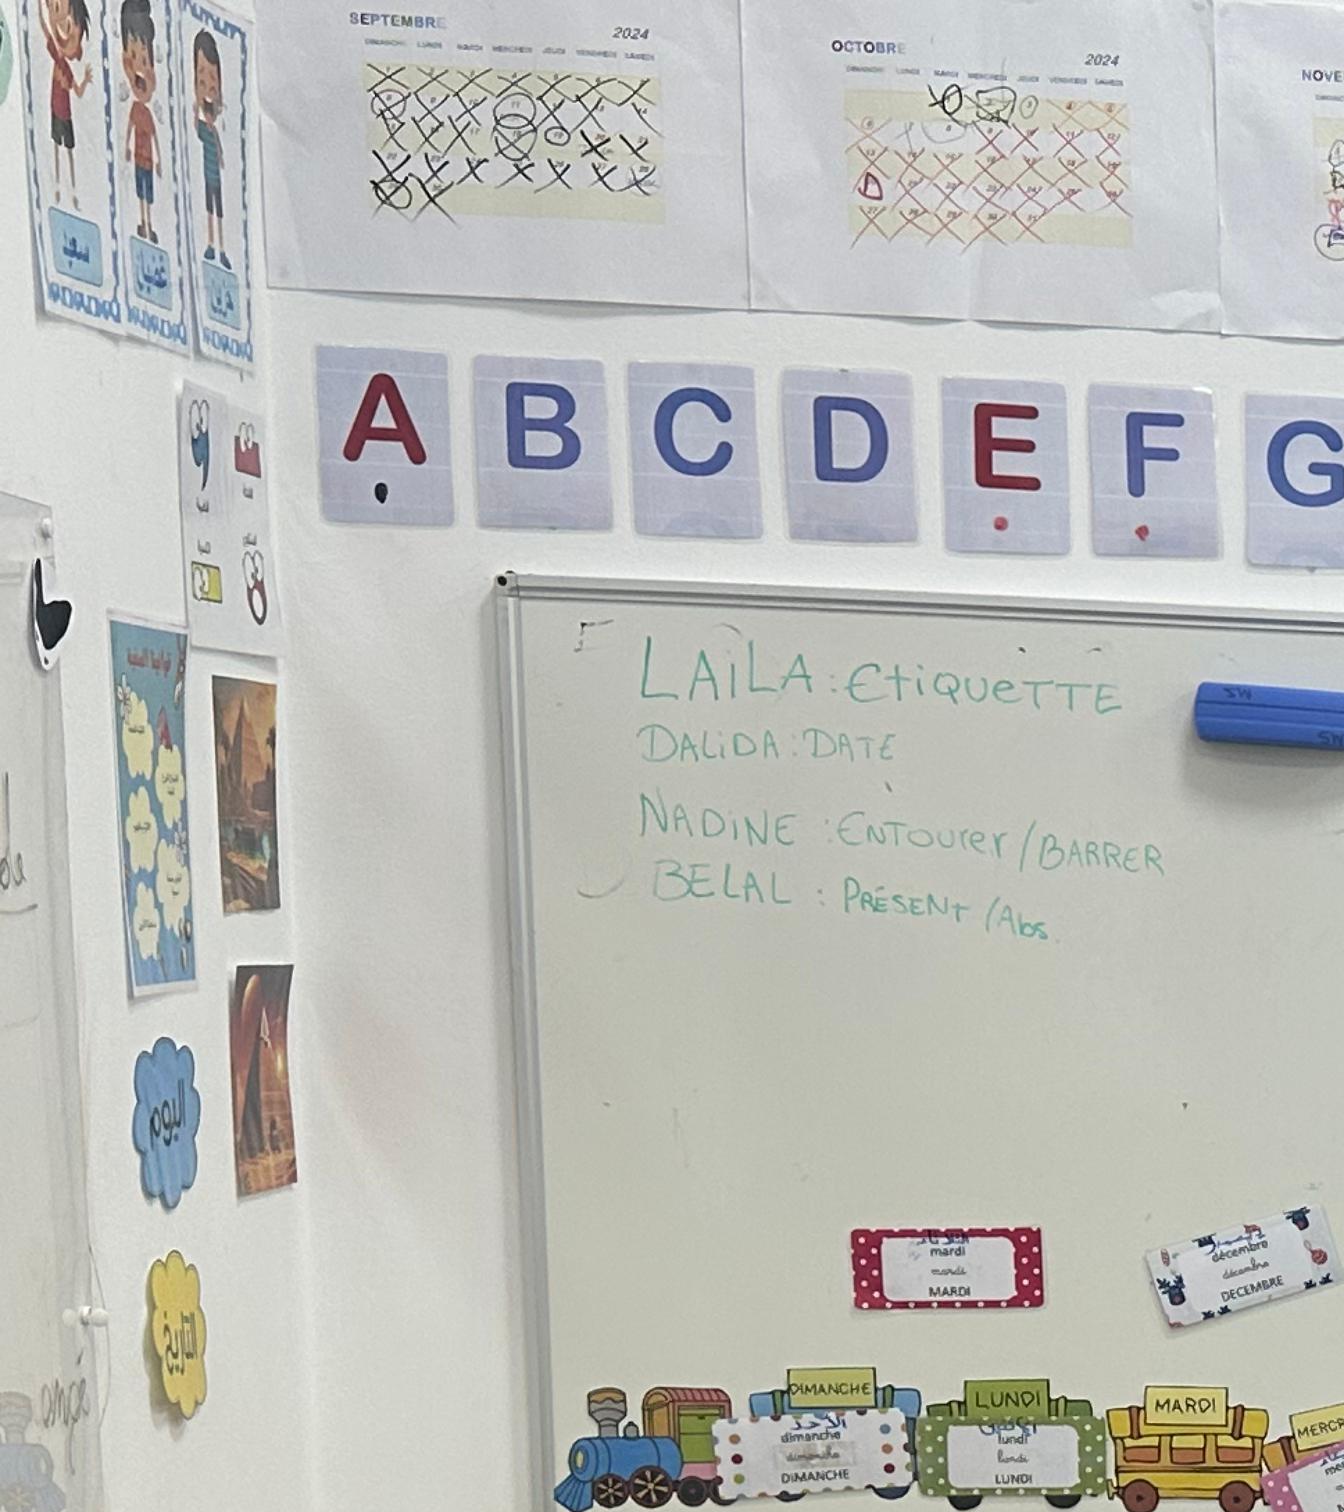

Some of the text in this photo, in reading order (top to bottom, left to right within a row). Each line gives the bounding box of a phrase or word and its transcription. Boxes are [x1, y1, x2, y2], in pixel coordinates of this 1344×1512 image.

[350, 12, 446, 29] SEPTEMBRE
[612, 27, 651, 41] 2024
[832, 39, 905, 55] OCTOBRE
[1084, 53, 1120, 67] 2024
[343, 373, 427, 465] A
[505, 382, 582, 470] B
[654, 386, 734, 476] C
[813, 395, 889, 483] D
[974, 403, 1041, 491] E
[1126, 412, 1185, 497] F
[803, 729, 896, 761] DATE
[653, 858, 792, 905] BELAL
[150, 1078, 186, 1149] اليوم
[928, 1286, 971, 1298] MARDI
[1220, 1274, 1284, 1304] DECEMBRE
[163, 1312, 197, 1376] التاريخ
[788, 1382, 872, 1397] DIMANCHE
[975, 1390, 1041, 1409] LUNDI
[1154, 1396, 1217, 1416] MARDI
[781, 1470, 849, 1484] DIMANCHE
[995, 1473, 1033, 1485] LUNDI
